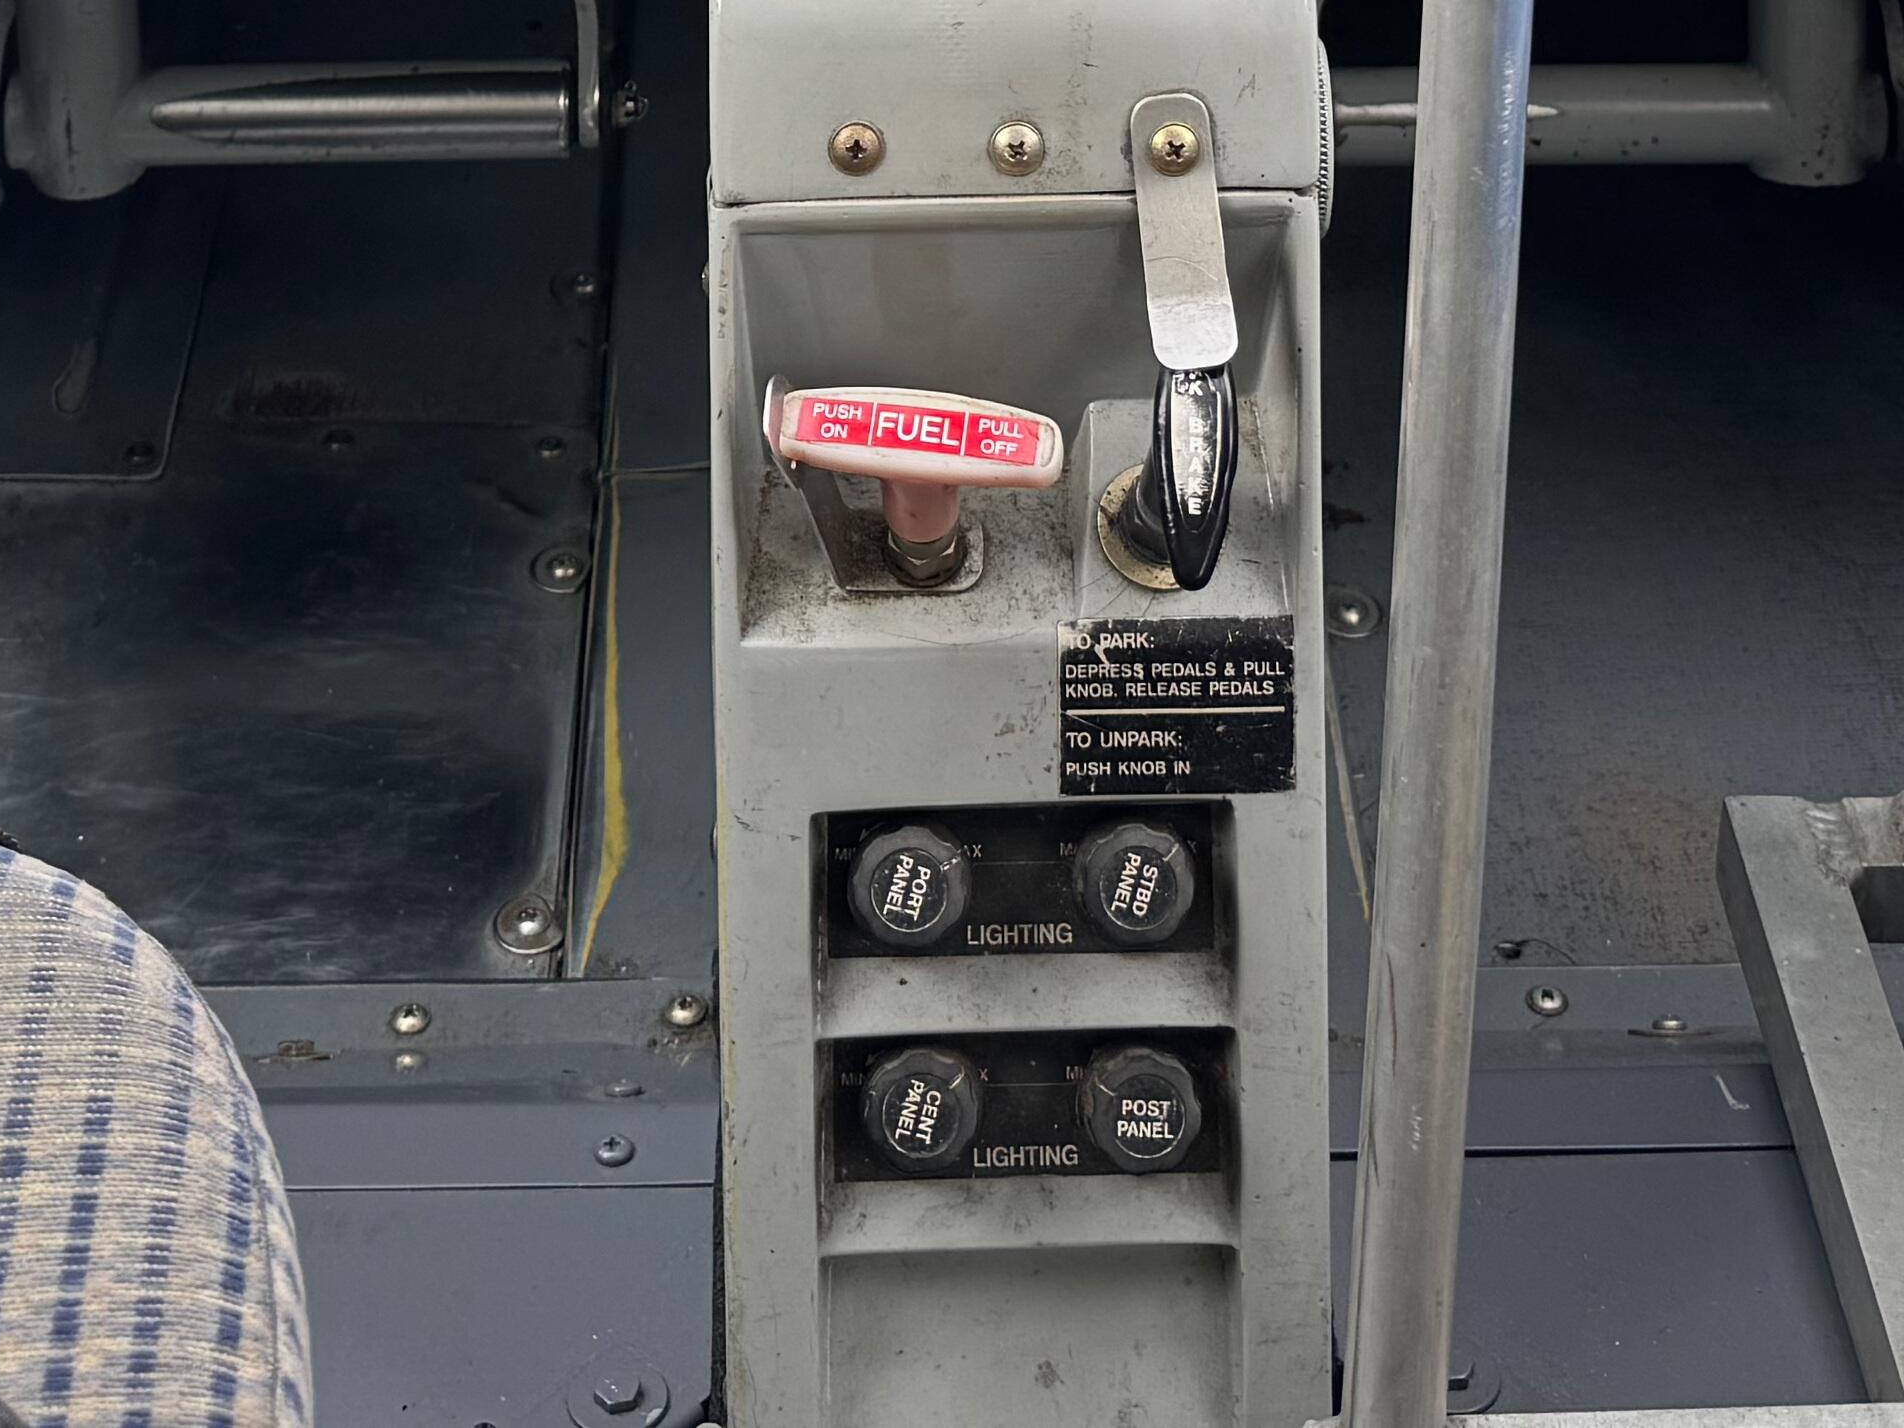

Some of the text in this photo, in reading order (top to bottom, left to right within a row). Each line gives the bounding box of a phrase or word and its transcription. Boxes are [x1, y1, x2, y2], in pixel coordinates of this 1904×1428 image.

[813, 403, 862, 420] PUSH
[821, 423, 848, 440] ON
[876, 411, 959, 446] FUEL
[978, 418, 1023, 438] PULL
[980, 439, 1017, 457] OFF
[1066, 660, 1285, 679] DEPRESS PEDALS & PULL
[1066, 731, 1182, 748] TO UNPARK:
[967, 923, 1073, 946] LIGHTING
[1122, 1100, 1170, 1116] POST
[1117, 1122, 1174, 1139] PANEL
